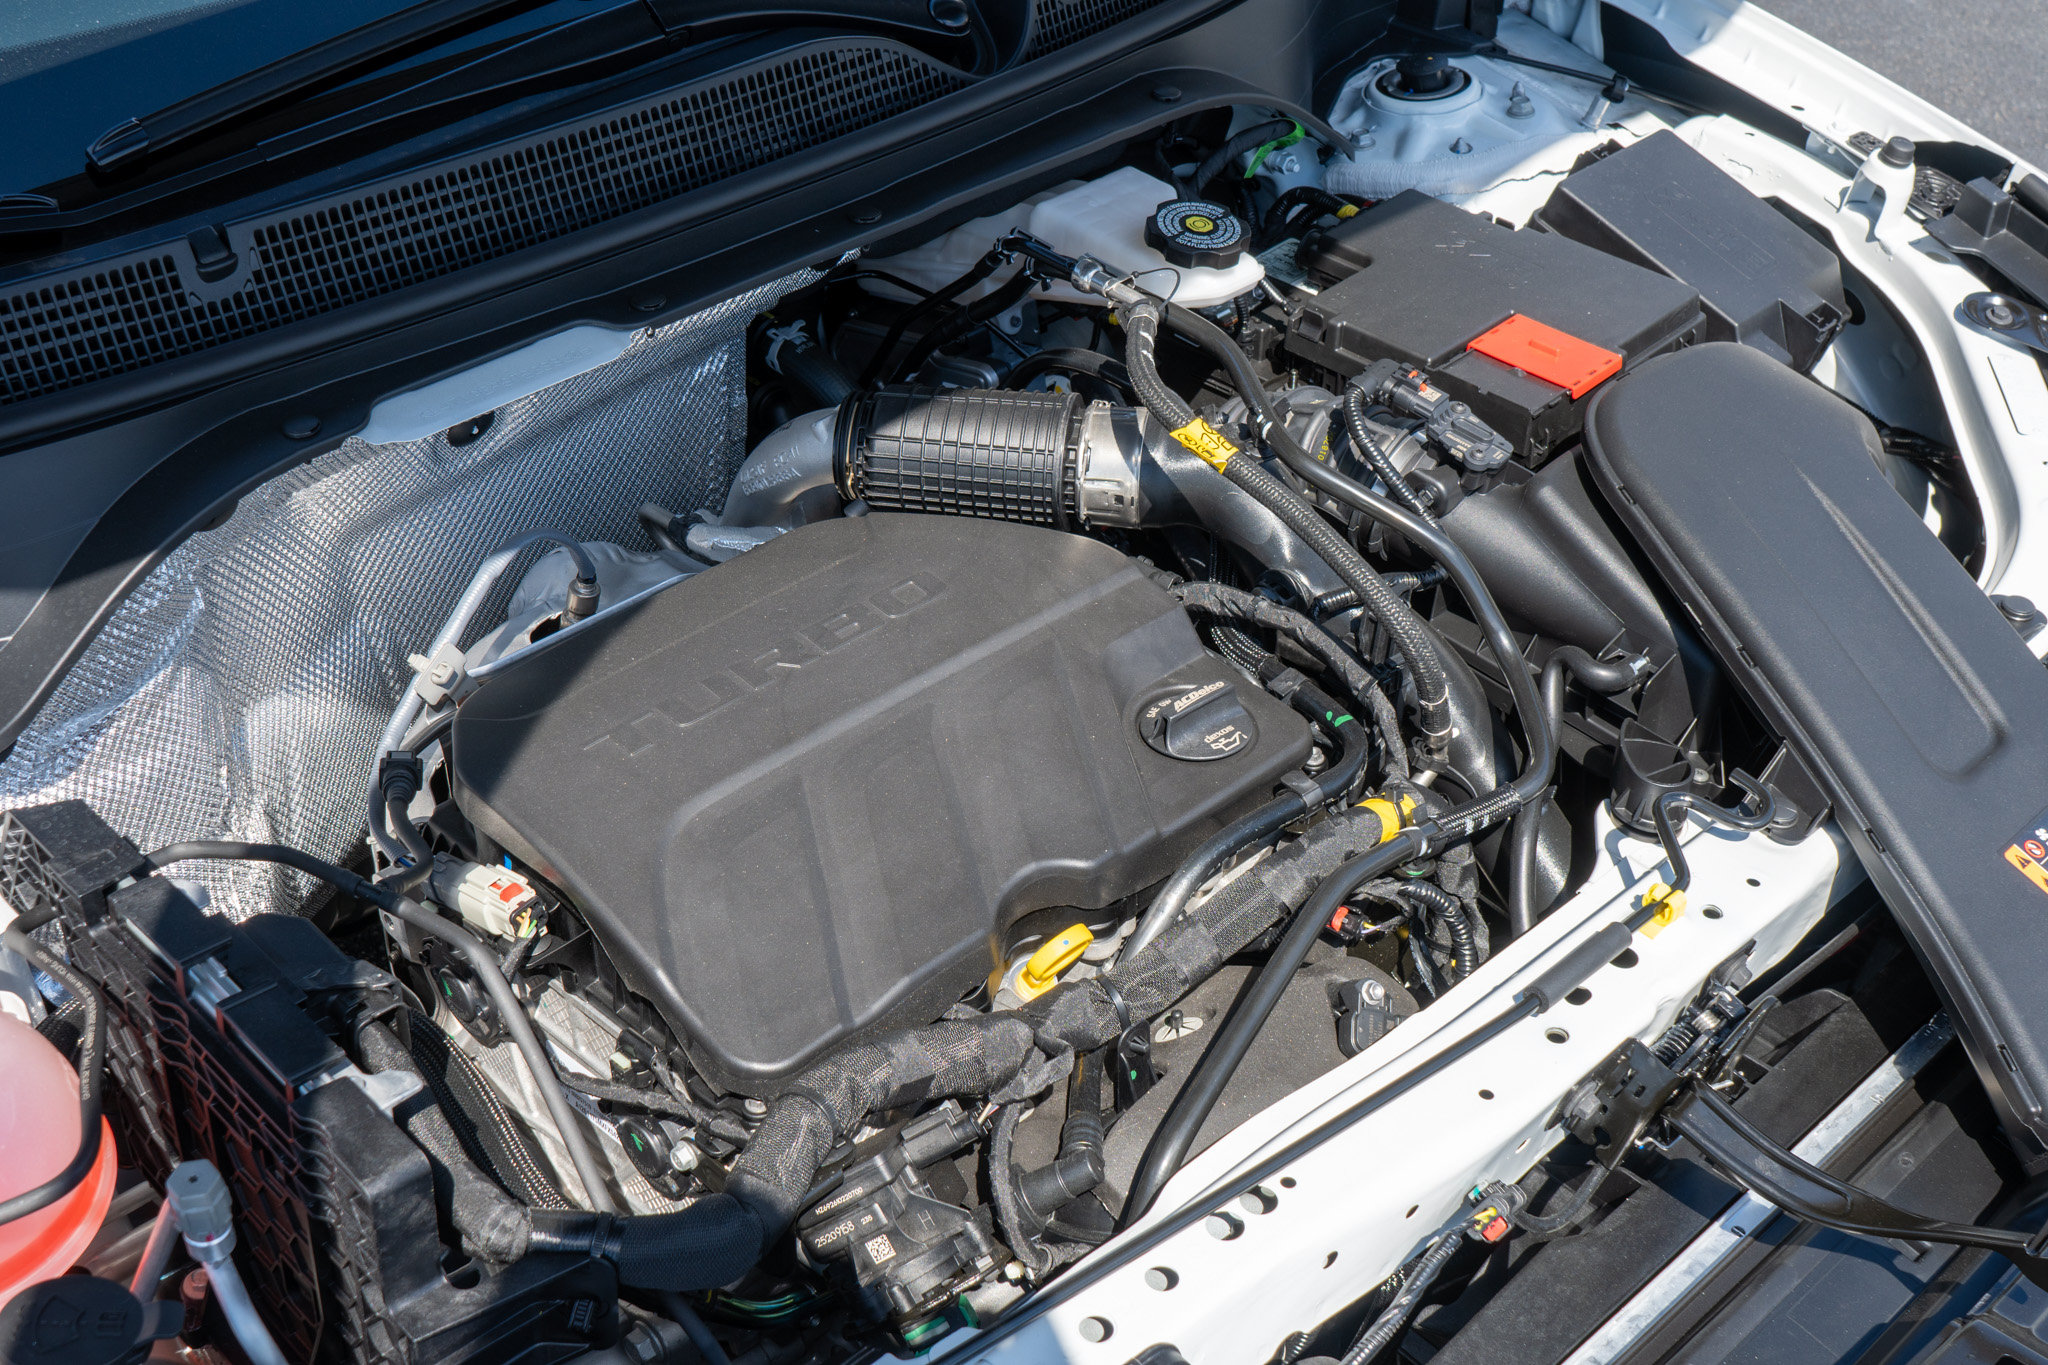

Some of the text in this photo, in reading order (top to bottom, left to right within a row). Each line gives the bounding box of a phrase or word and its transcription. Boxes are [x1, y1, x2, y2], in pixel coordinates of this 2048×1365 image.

[583, 570, 950, 758] TURBO
[1174, 681, 1225, 713] ACDelco
[1146, 706, 1160, 718] SAE
[1204, 725, 1235, 743] dexos
